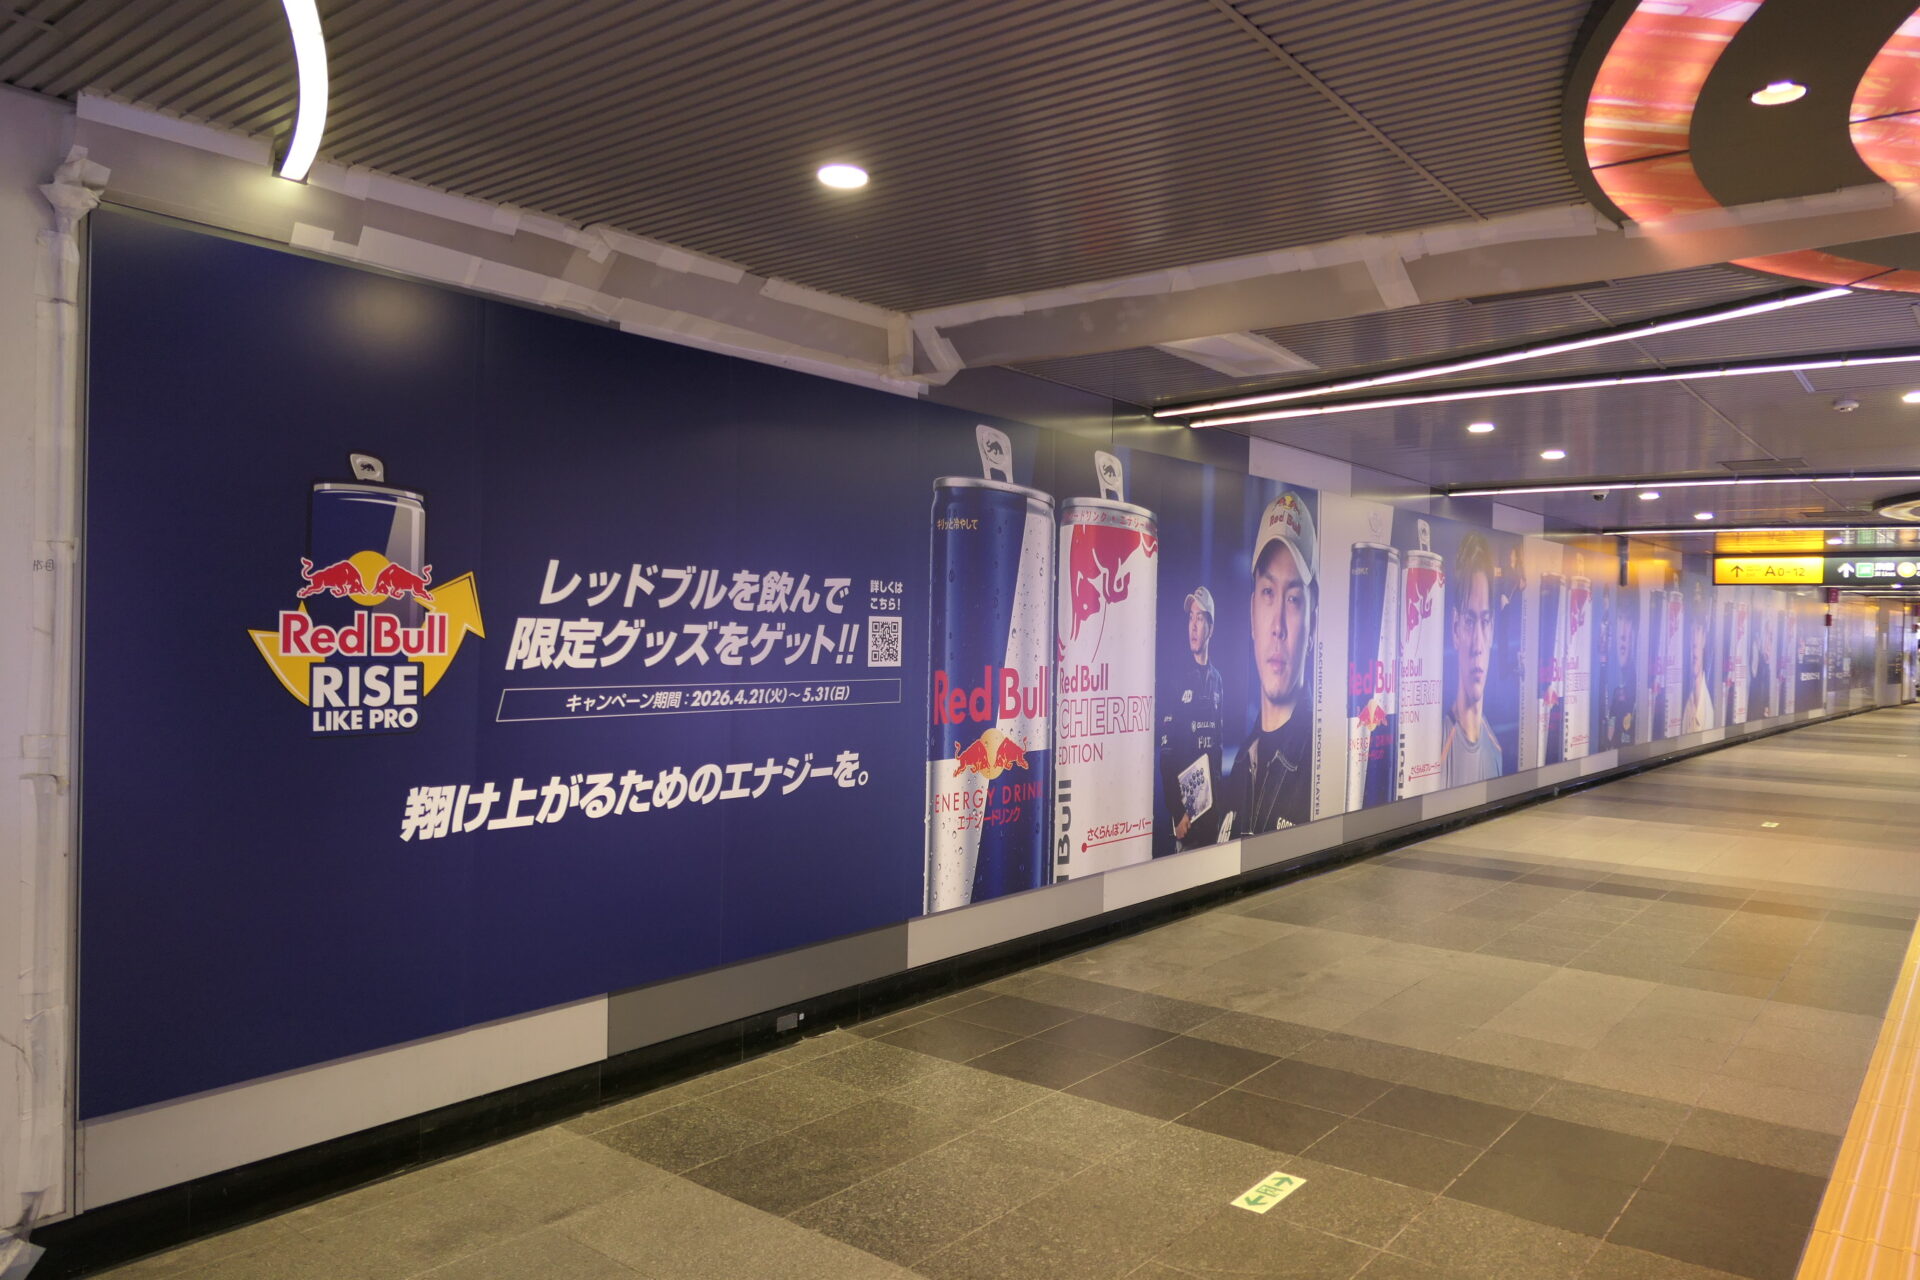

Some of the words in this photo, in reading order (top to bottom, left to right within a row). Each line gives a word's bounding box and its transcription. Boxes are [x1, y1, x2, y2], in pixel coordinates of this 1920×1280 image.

[539, 558, 852, 614] レッドブルを飲んで
[870, 579, 903, 594] 詳しくは
[280, 611, 367, 655] Red
[372, 612, 448, 656] Bull
[311, 664, 419, 708] RISE
[934, 665, 992, 725] Red
[999, 665, 1049, 720] Bull
[1059, 665, 1079, 694] Red
[1080, 663, 1109, 693] Bull
[312, 710, 364, 732] LIKE
[368, 707, 419, 730] PRO
[1058, 695, 1153, 739] CHERRY
[1058, 743, 1104, 766] EDITION
[400, 750, 869, 842] 翔け上がるためのエナジーを。
[934, 789, 996, 814] ENERGY
[957, 806, 1021, 831] エナジードリンク
[1057, 779, 1072, 866] Bull
